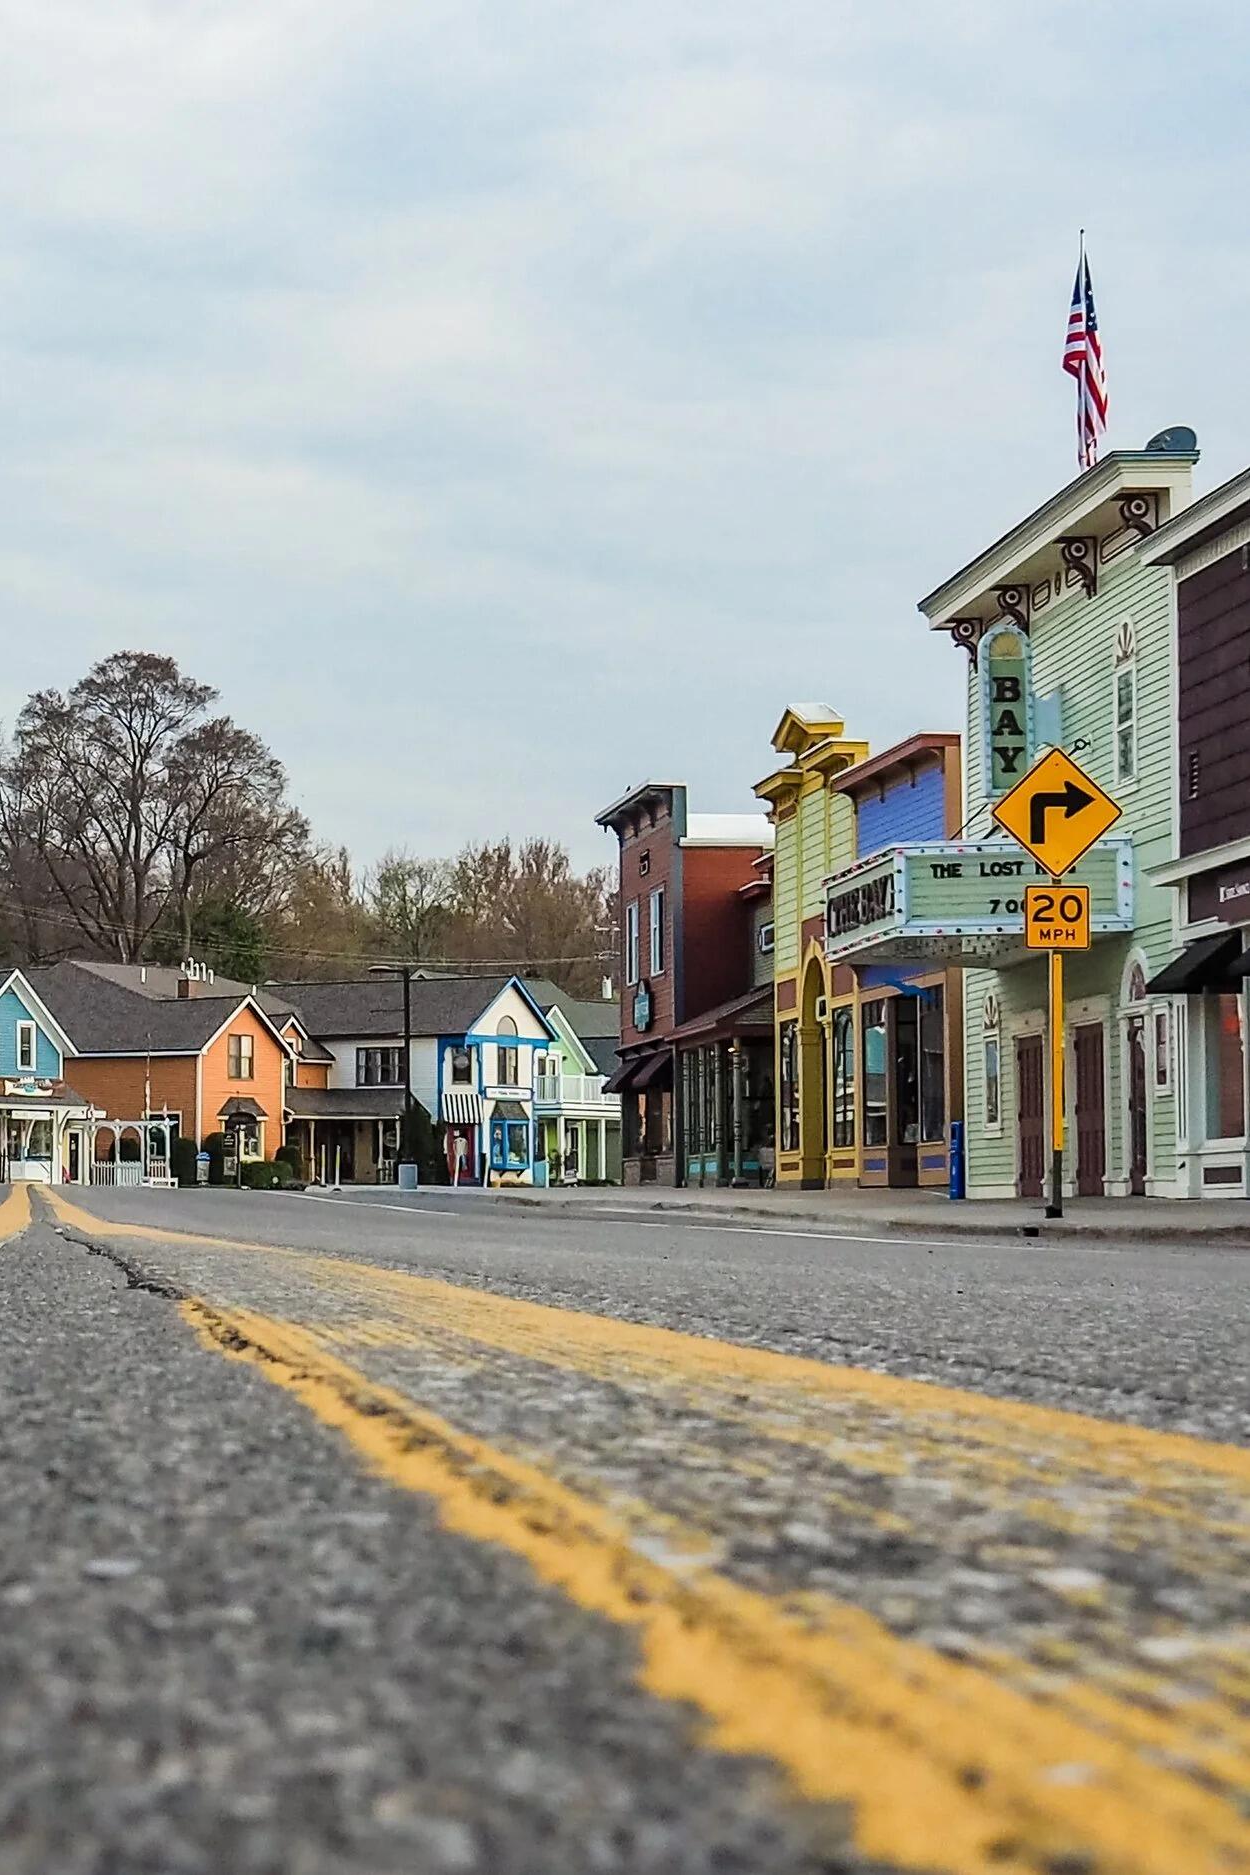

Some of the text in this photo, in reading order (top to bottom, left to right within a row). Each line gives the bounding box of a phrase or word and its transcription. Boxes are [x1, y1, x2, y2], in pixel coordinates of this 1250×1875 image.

[992, 676, 1026, 773] BAY
[930, 862, 962, 879] THE
[979, 860, 1024, 877] LOST
[1032, 894, 1083, 923] 20
[1039, 929, 1076, 941] MPH
